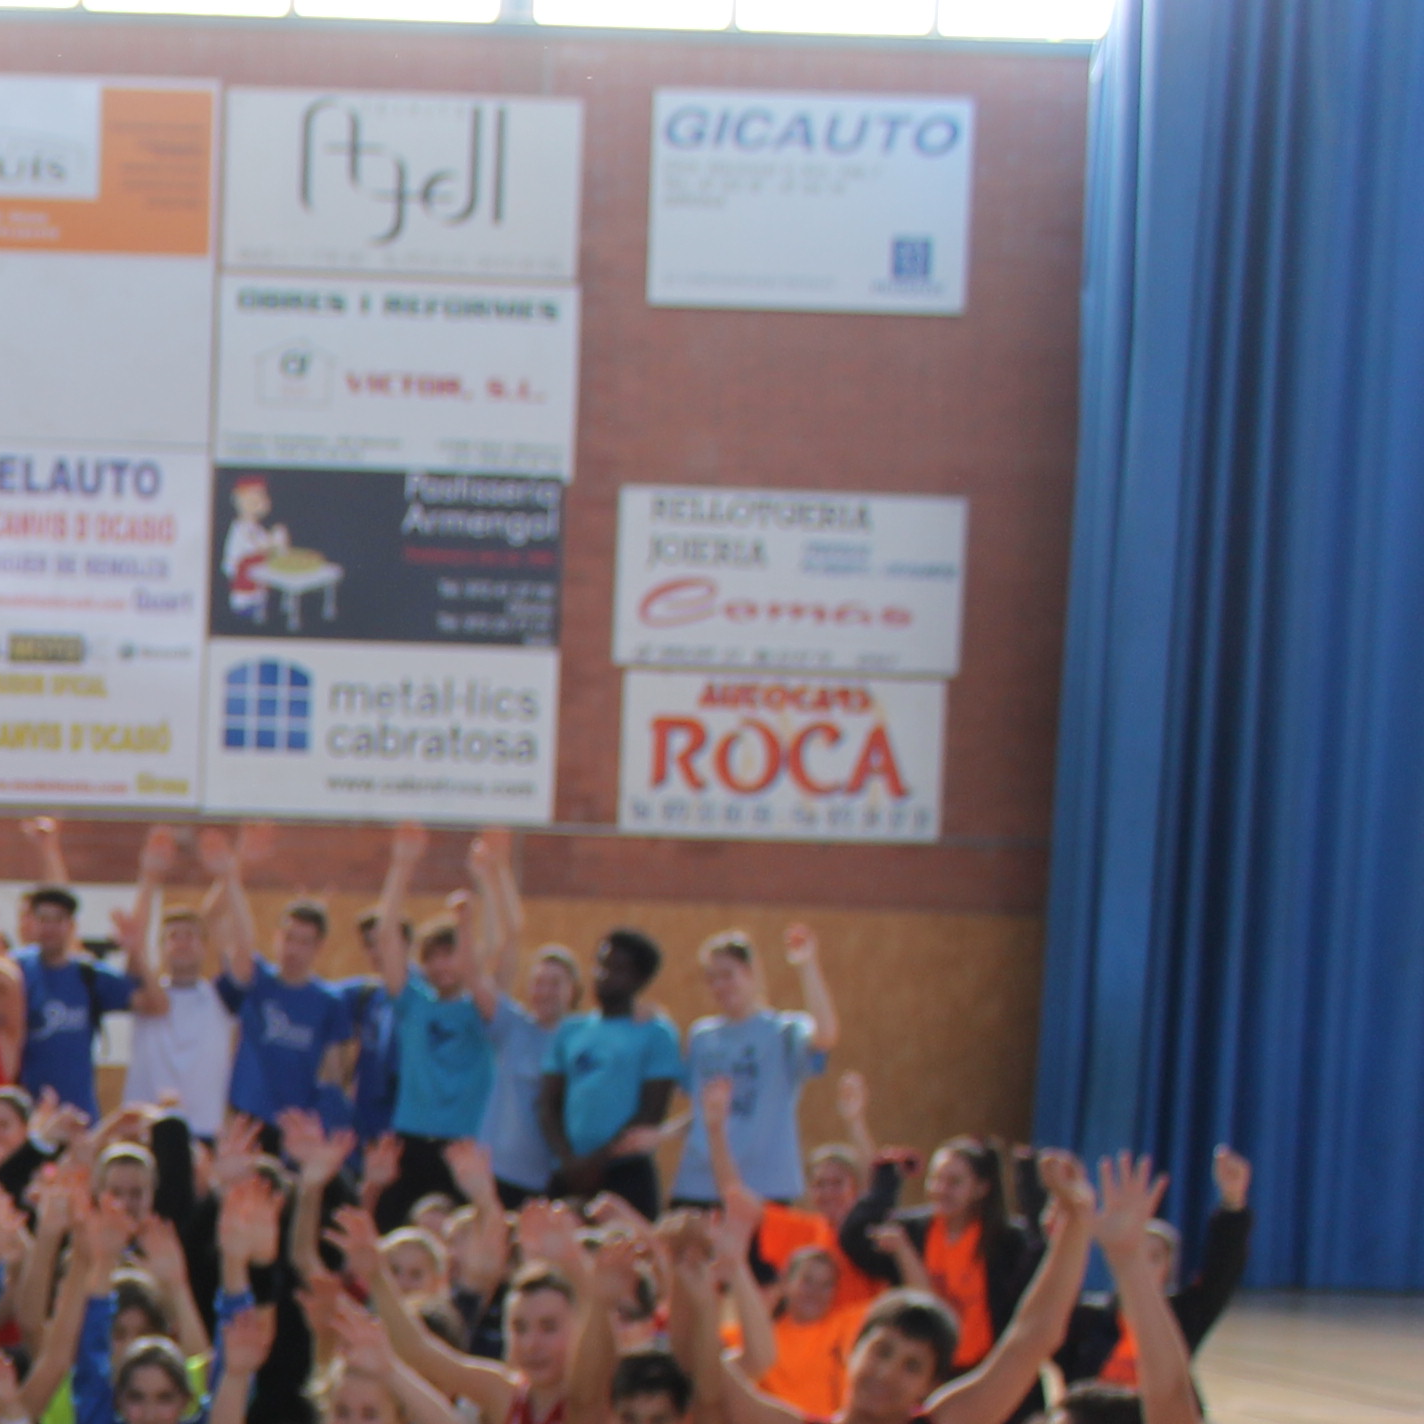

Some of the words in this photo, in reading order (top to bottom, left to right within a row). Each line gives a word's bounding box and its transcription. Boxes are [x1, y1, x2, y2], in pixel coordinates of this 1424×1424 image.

[664, 104, 961, 157] GICAUTO
[237, 287, 347, 313] OBRES
[401, 502, 560, 546] Armengol
[698, 682, 873, 715] AUTOCARS
[326, 721, 538, 765] cabratosa
[649, 715, 909, 799] ROCA
